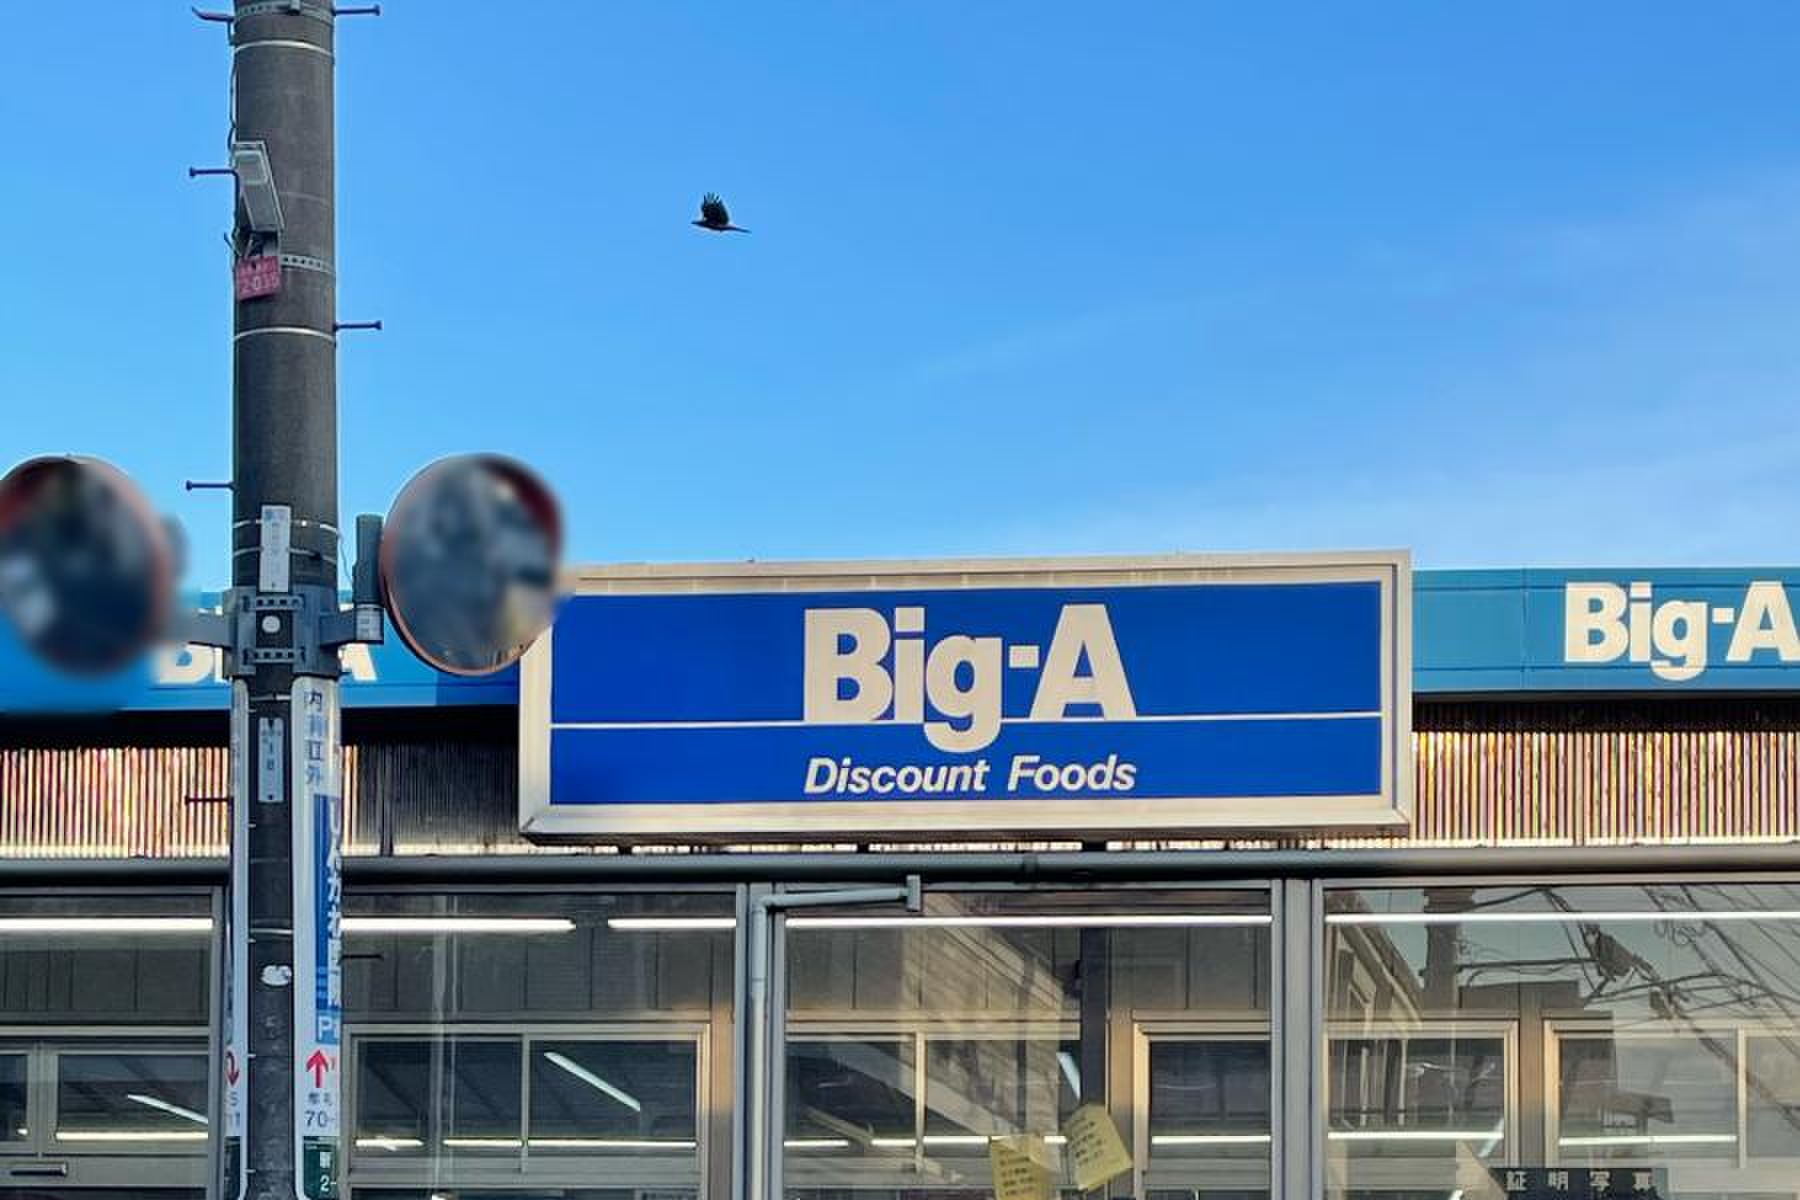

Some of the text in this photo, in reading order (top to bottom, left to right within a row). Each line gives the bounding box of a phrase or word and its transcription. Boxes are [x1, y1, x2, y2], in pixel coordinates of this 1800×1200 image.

[803, 603, 1137, 753] Big-A
[1565, 581, 1800, 681] Big-A
[803, 754, 1137, 794] Discount Foods
